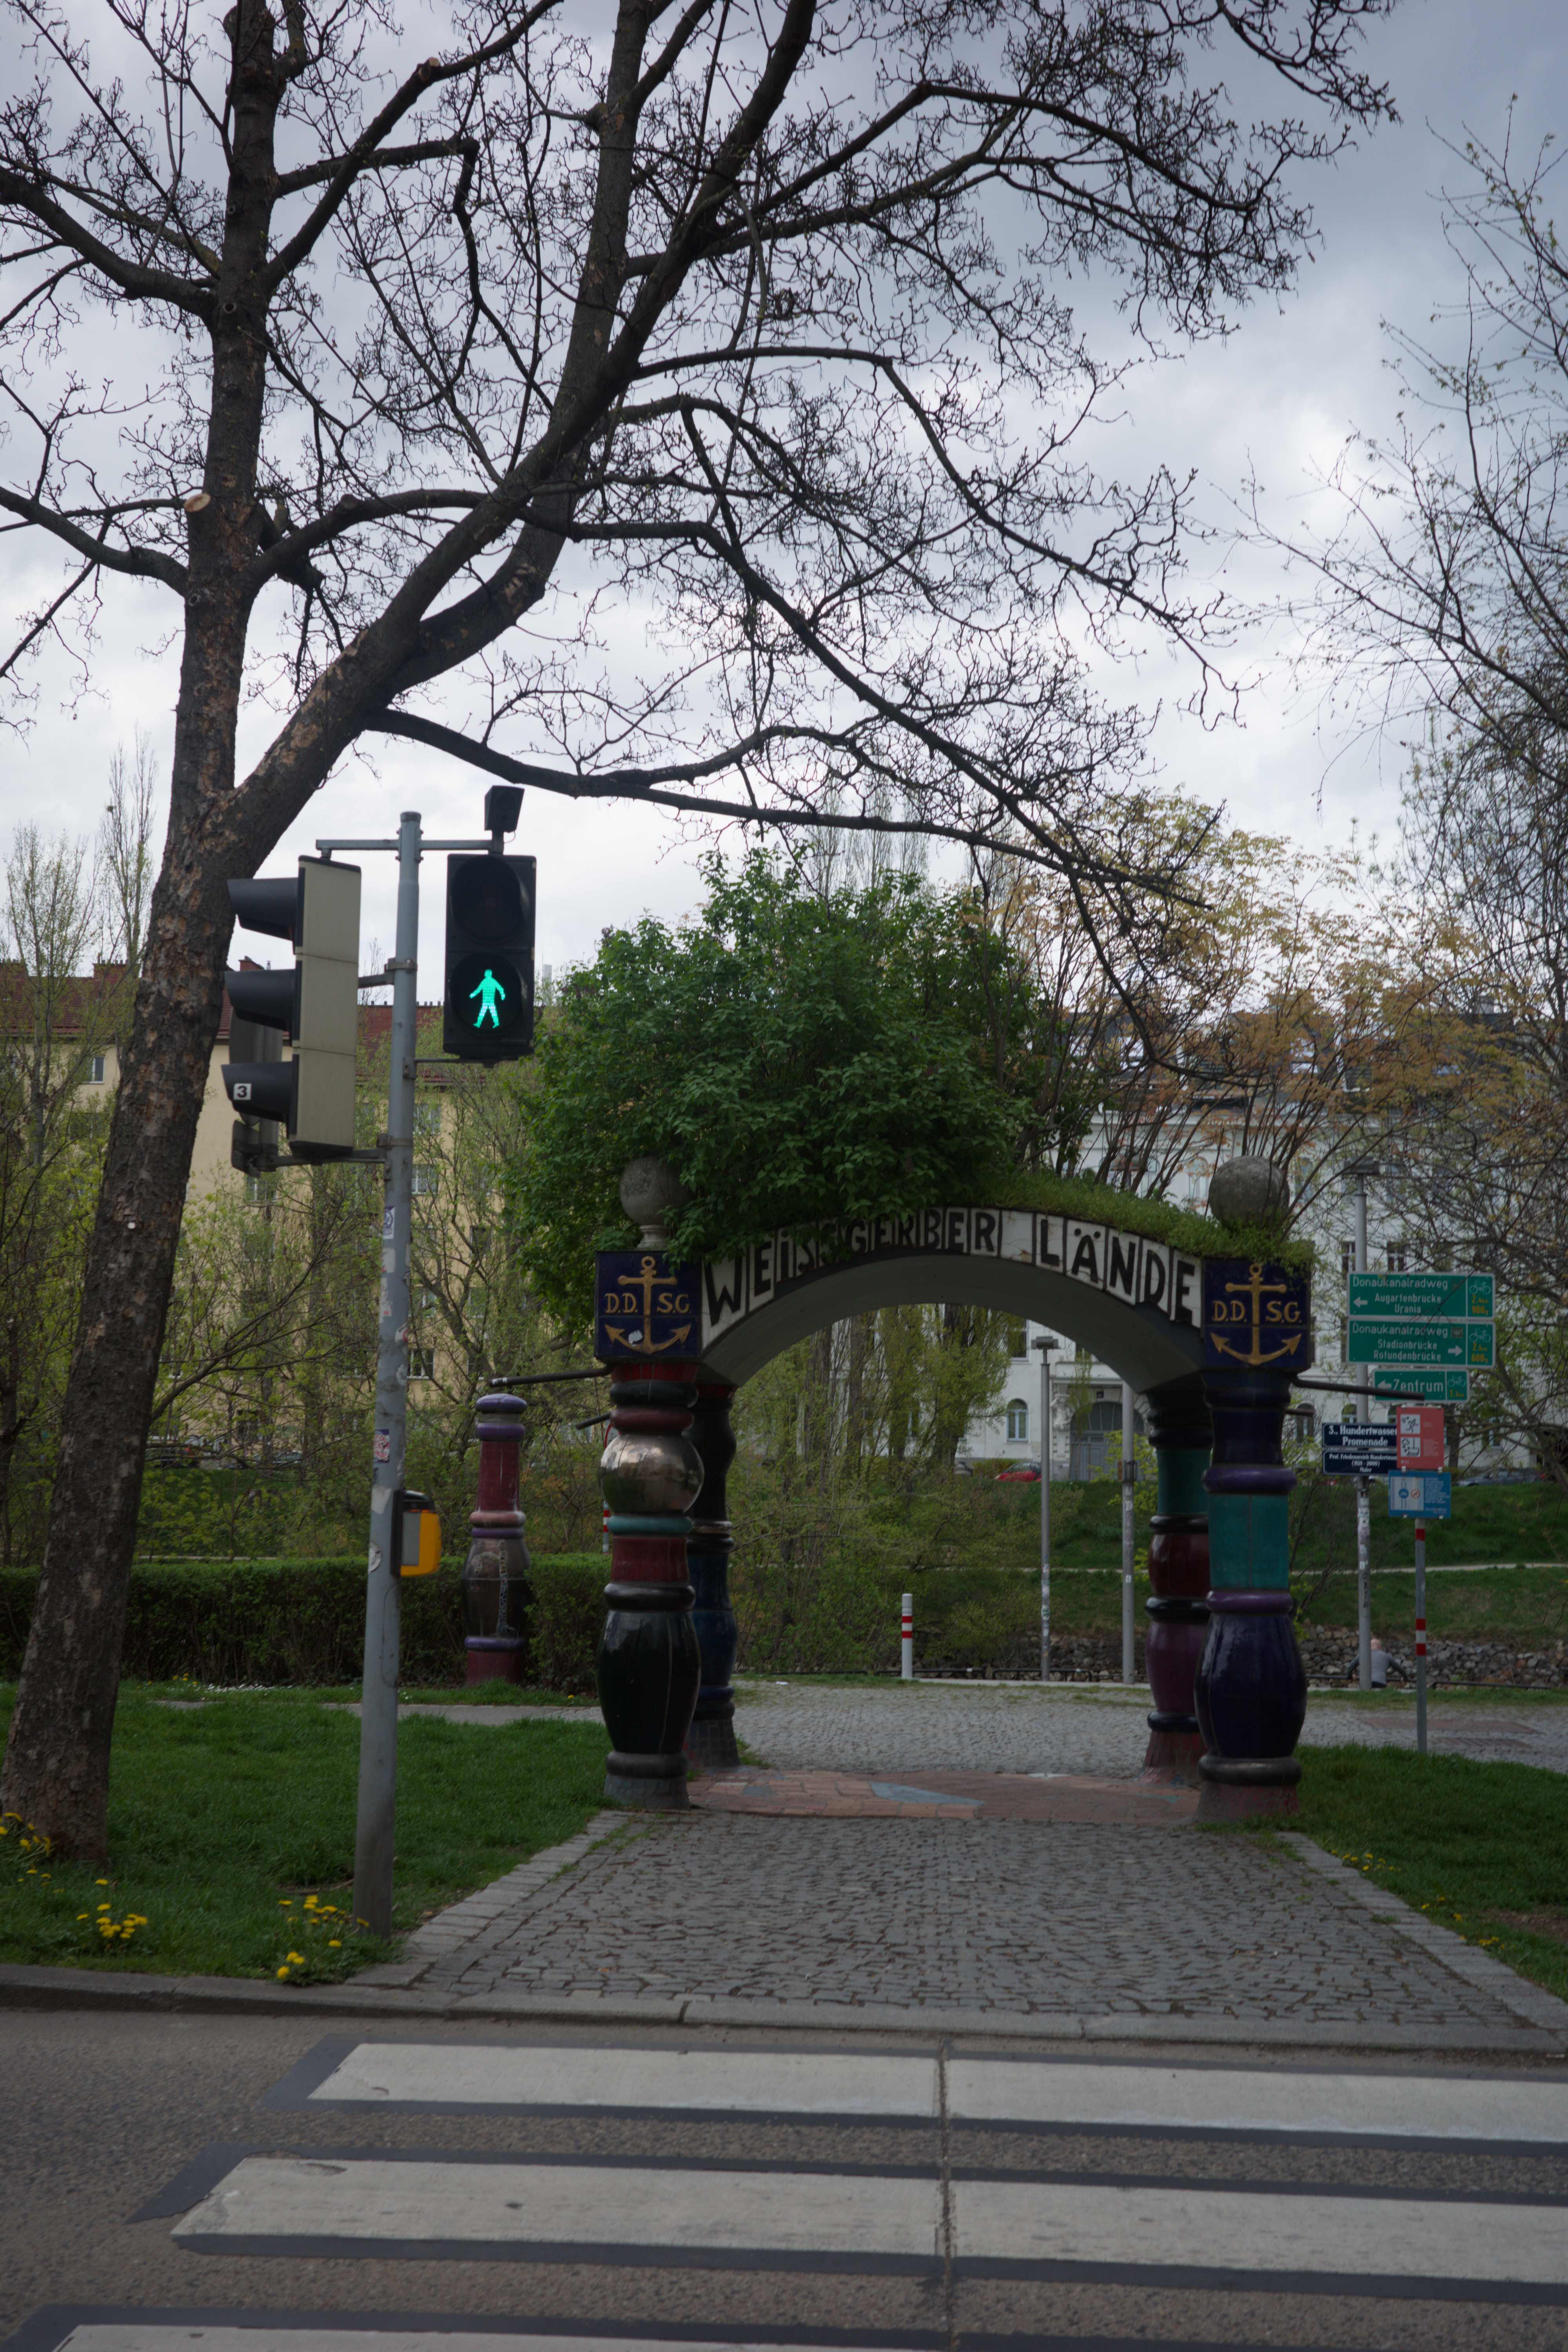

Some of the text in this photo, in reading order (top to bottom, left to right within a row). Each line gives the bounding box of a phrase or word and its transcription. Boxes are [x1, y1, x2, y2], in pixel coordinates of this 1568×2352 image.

[237, 1085, 247, 1098] 3
[1040, 1213, 1196, 1323] LÄNDE
[1352, 1276, 1448, 1291] Donaukanalradweg
[1374, 1292, 1442, 1305] Augartenbrücke
[1394, 1304, 1421, 1314] Urania
[1352, 1323, 1448, 1339] Donaukanalradweg
[1377, 1339, 1437, 1351] Stadionbrücke
[1373, 1350, 1441, 1362] Rotundenbrücke
[1393, 1378, 1443, 1393] Zentrum
[1342, 1436, 1388, 1446] Promenade
